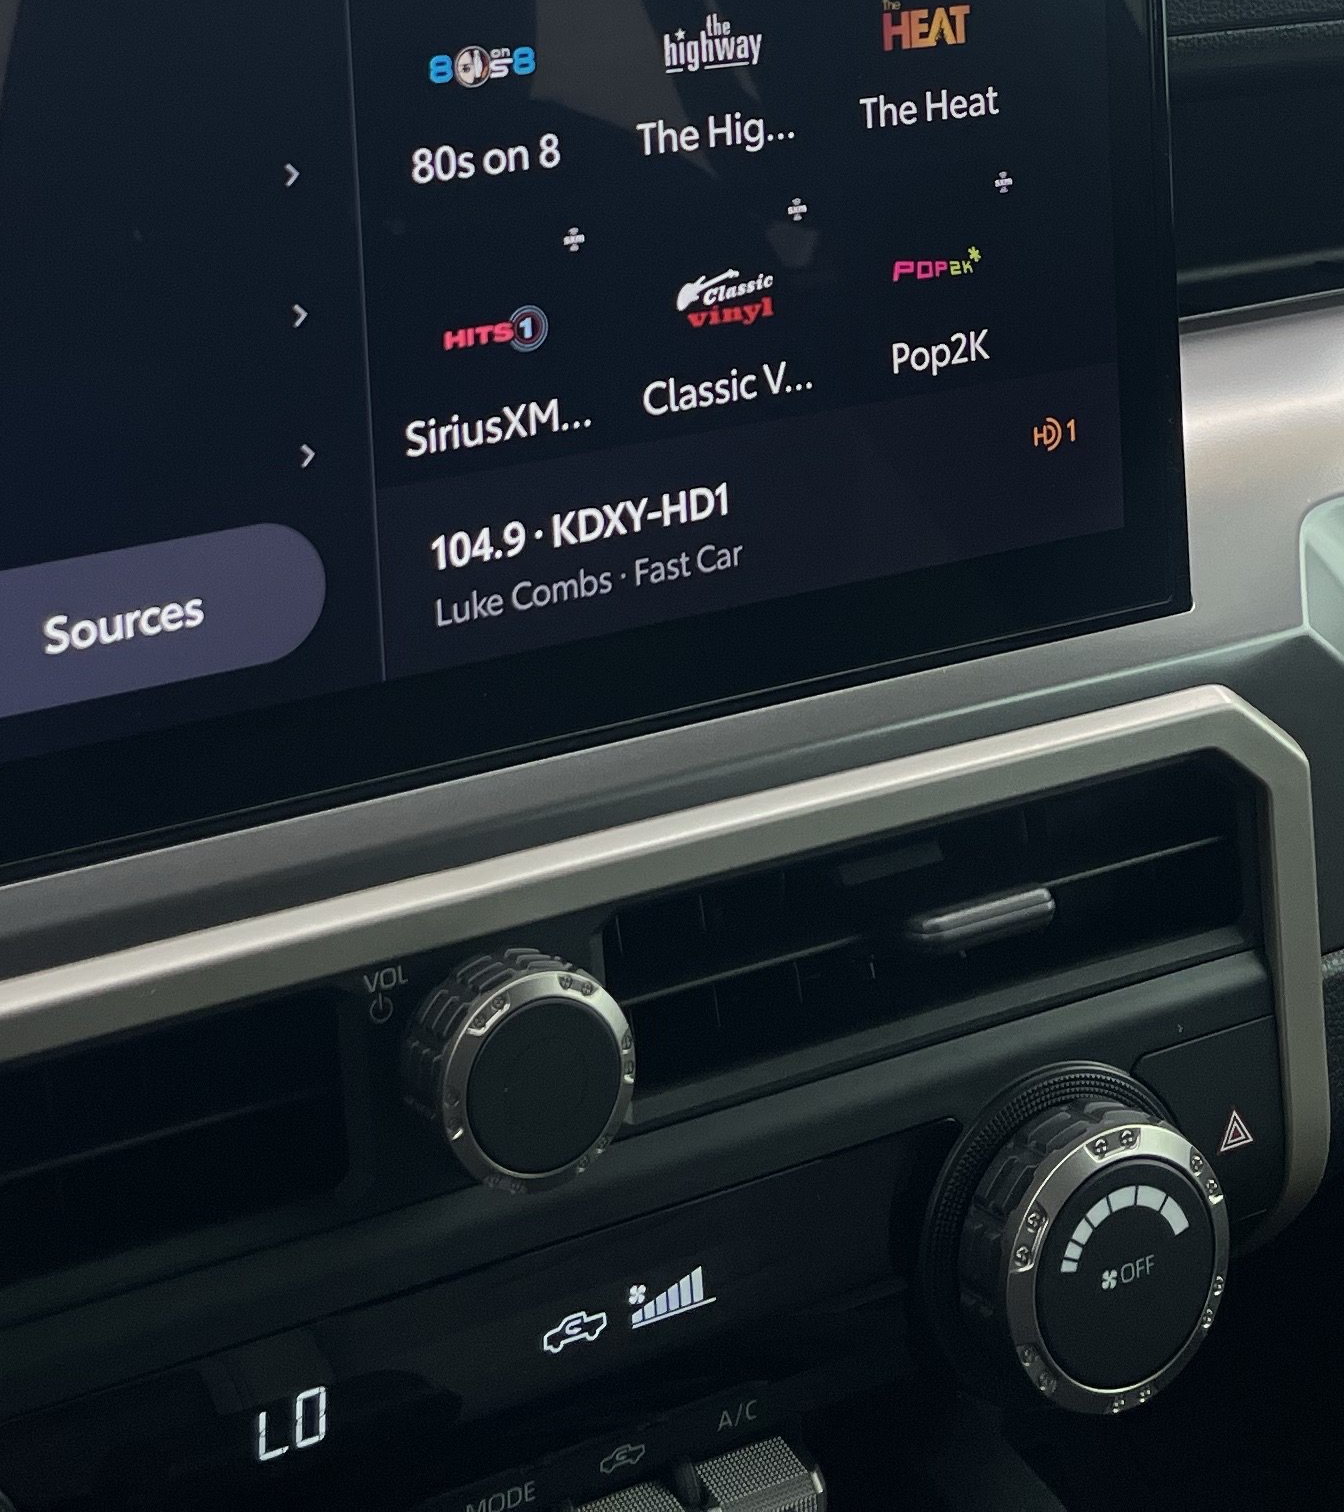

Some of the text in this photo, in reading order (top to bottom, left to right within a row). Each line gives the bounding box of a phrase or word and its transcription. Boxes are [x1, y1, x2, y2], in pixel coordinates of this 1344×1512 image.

[706, 13, 731, 37] the
[882, 4, 971, 52] HEAT
[663, 30, 763, 72] highway
[859, 87, 1000, 129] The Heat
[411, 133, 563, 185] 80s on 8
[637, 120, 700, 158] The
[703, 272, 775, 307] Classic
[686, 295, 775, 328] vinyl
[442, 321, 515, 352] HITS
[891, 328, 991, 378] Pop2K
[642, 367, 758, 418] Classic
[404, 395, 593, 459] SiriusXM...
[430, 481, 732, 571] 104.9 KDXY-HD1
[435, 539, 745, 628] Luke Combs Fast Car
[43, 597, 206, 656] Sources
[363, 964, 409, 992] VOL
[1120, 1254, 1155, 1285] OFF
[717, 1399, 757, 1432] A/C
[464, 1480, 537, 1512] MODE
